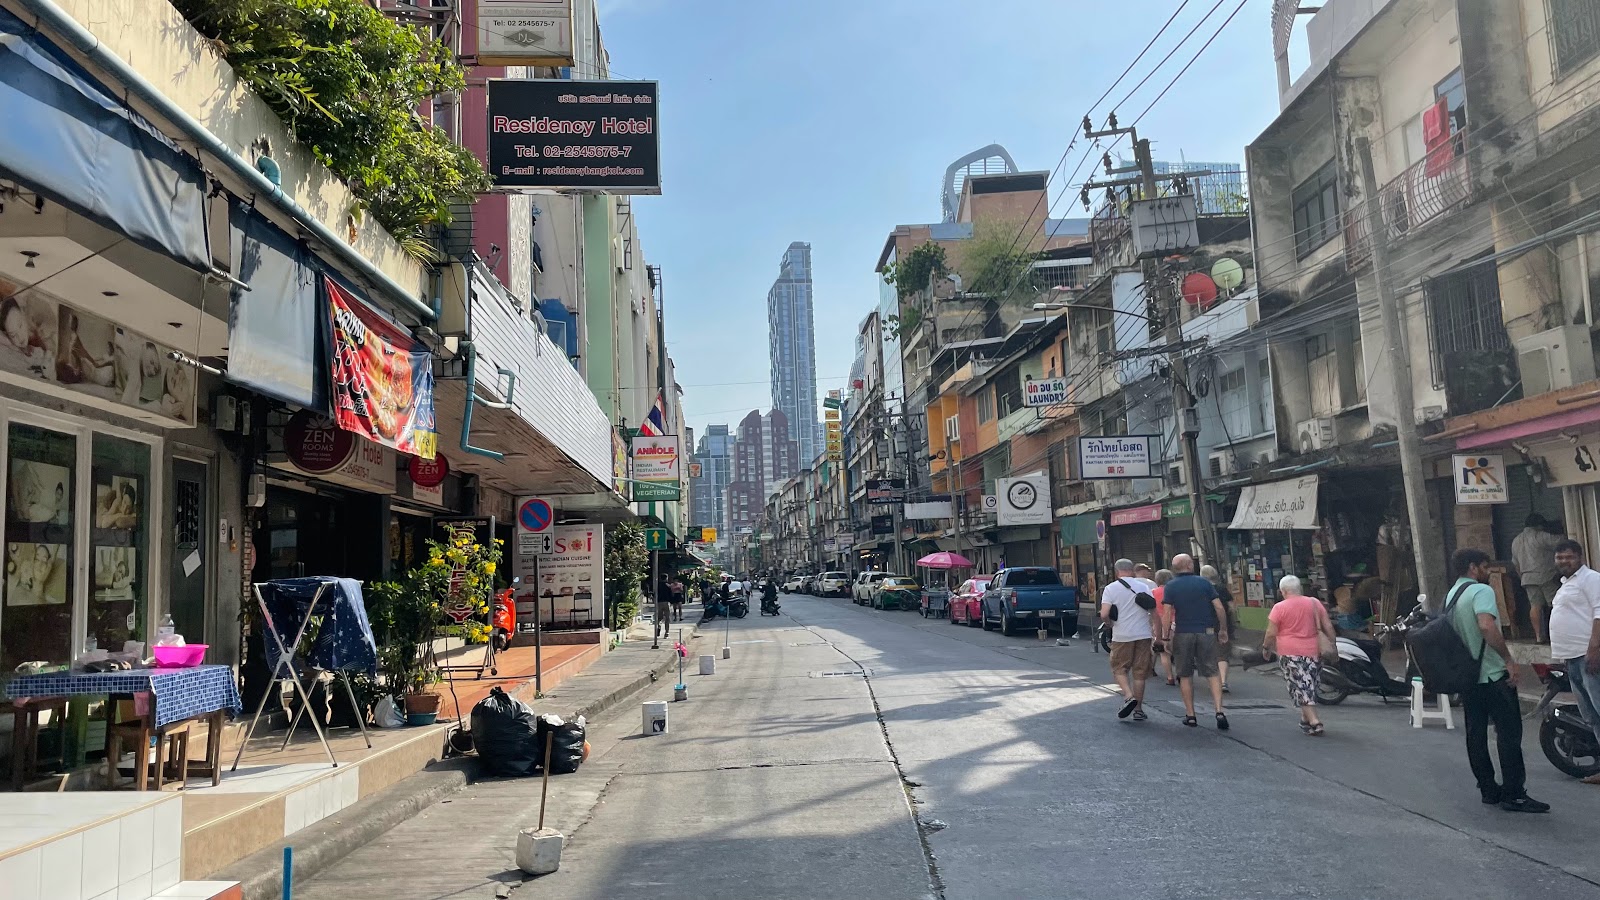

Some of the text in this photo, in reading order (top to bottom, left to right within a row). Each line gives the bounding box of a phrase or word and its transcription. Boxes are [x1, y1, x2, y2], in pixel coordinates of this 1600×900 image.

[494, 116, 652, 137] Residency Hotel
[514, 145, 632, 157] Tel. 02-2545675-7
[503, 166, 534, 175] E-mail
[543, 166, 644, 176] residencybangkok.com
[1029, 393, 1064, 404] LAUNDRY
[304, 430, 335, 443] ZEN
[1088, 440, 1142, 452] รักไทยโอสถ
[418, 466, 439, 475] ZEN
